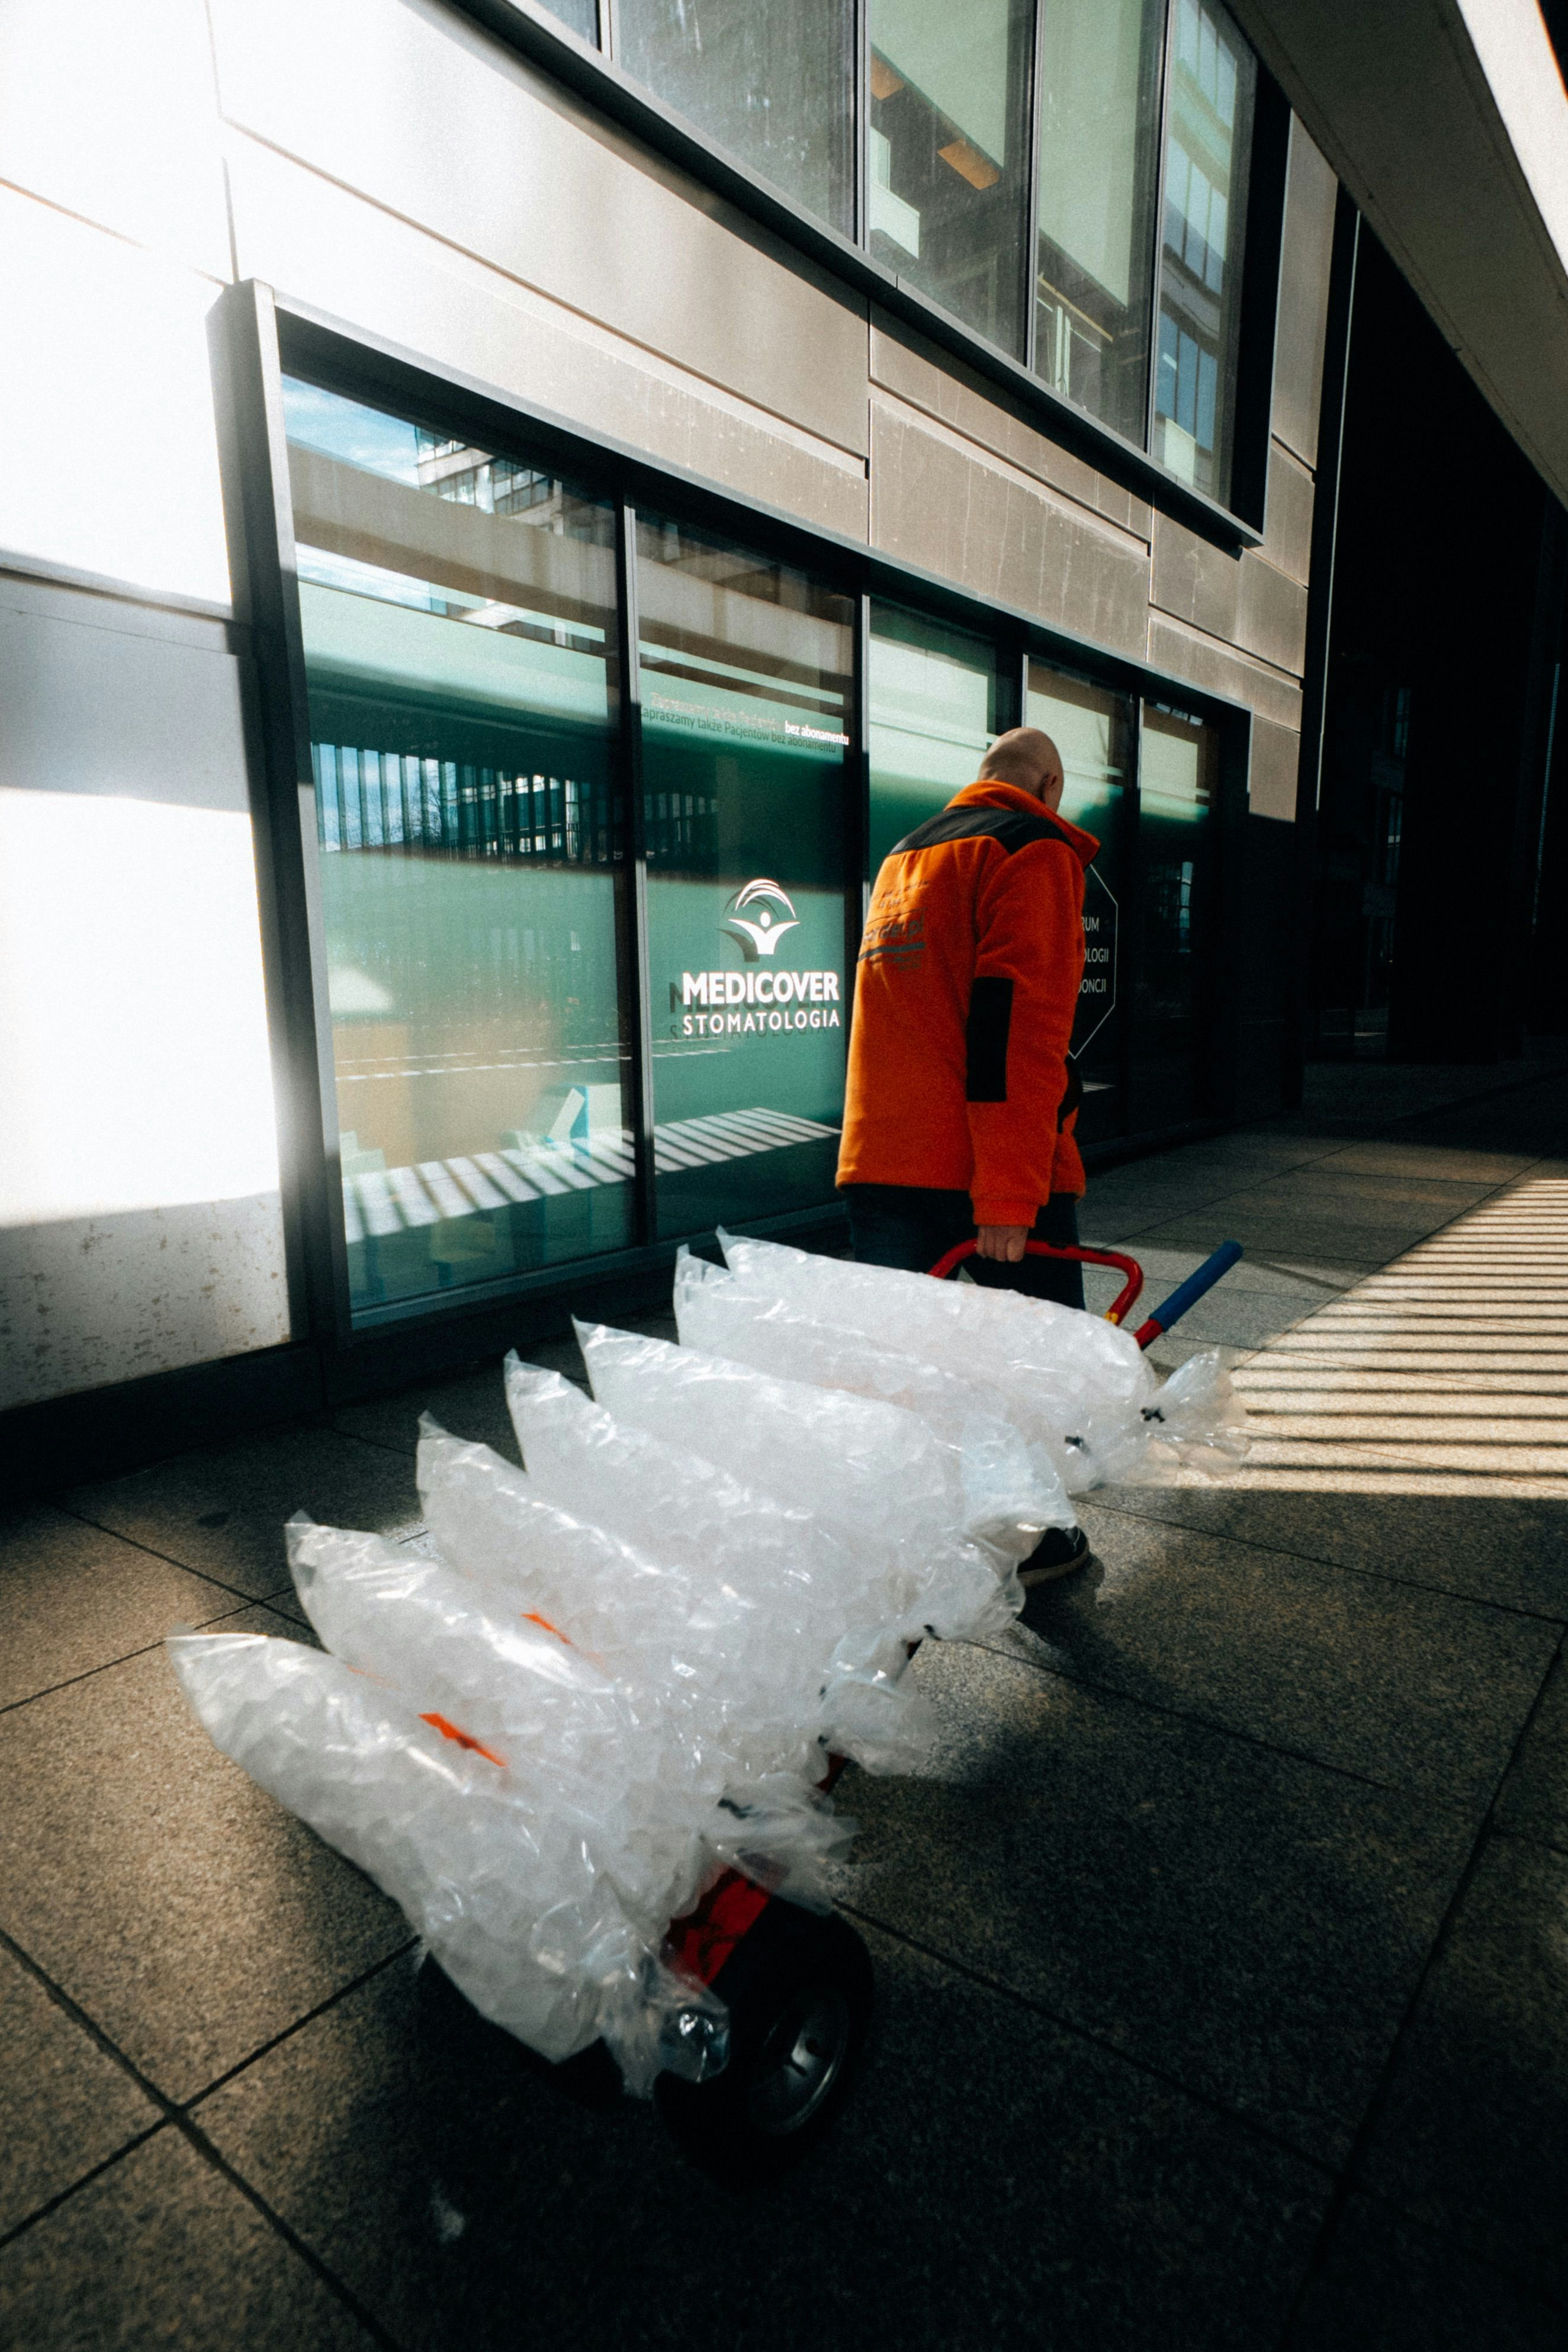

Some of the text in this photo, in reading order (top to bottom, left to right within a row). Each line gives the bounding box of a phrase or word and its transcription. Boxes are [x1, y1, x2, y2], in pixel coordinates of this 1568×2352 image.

[641, 708, 695, 730] apraszamy
[785, 720, 800, 735] bez
[801, 725, 850, 746] abonamentu
[682, 972, 840, 1005] MEDICOVER
[683, 1010, 840, 1035] STOMATOLOGIA
